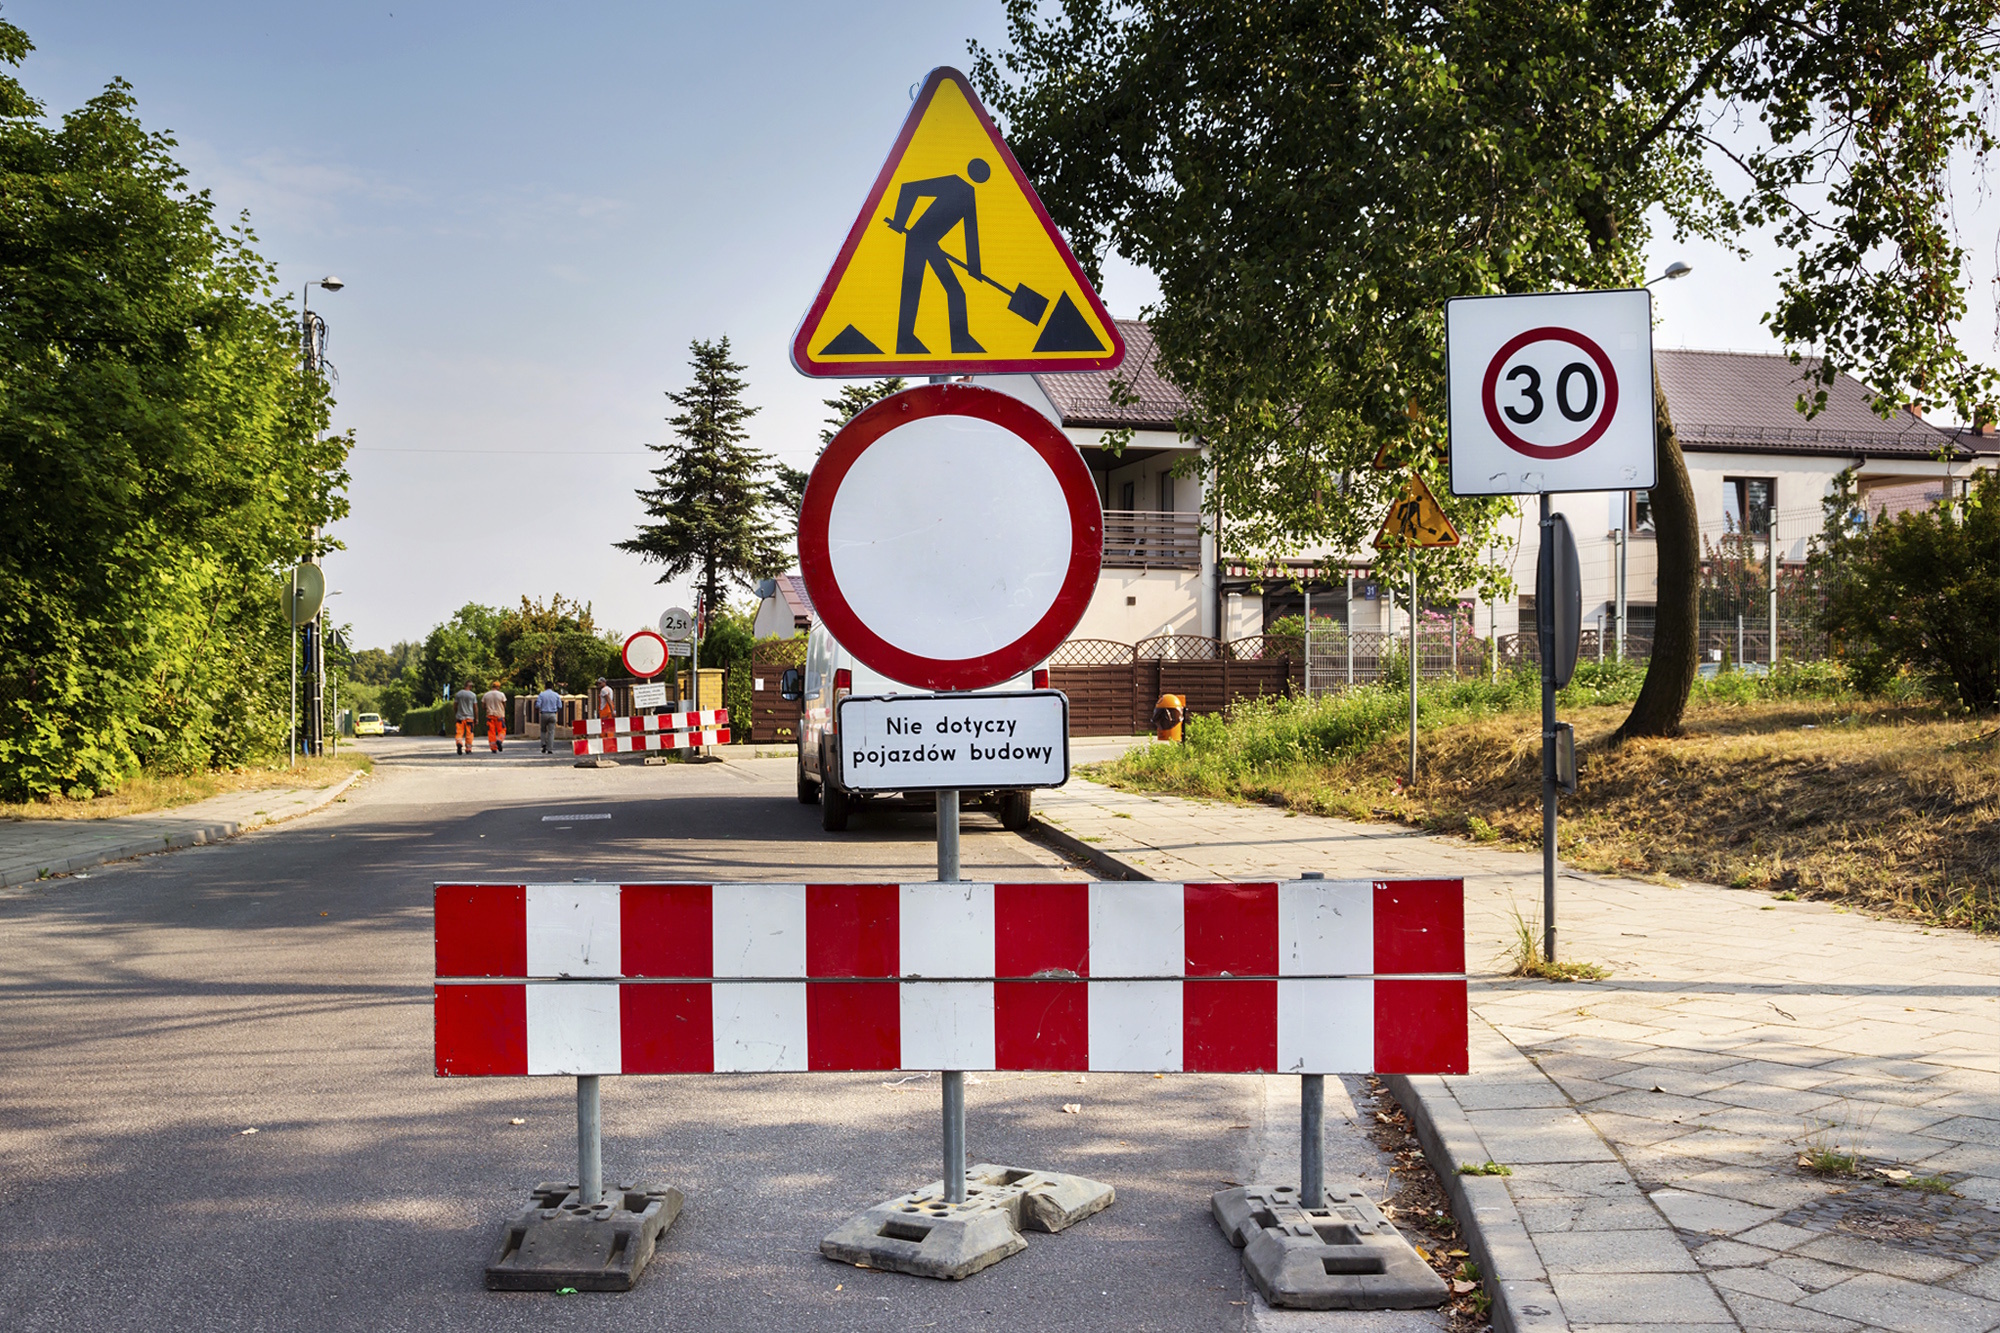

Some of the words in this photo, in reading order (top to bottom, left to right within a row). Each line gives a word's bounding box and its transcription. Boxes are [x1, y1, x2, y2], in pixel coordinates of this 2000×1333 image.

[1504, 362, 1598, 425] 30
[1366, 586, 1375, 596] 31
[666, 616, 687, 630] 2,5t
[887, 717, 922, 735] Nie
[936, 716, 1017, 738] dotyczy
[853, 743, 955, 768] pojazdów
[971, 742, 1053, 764] budowy
